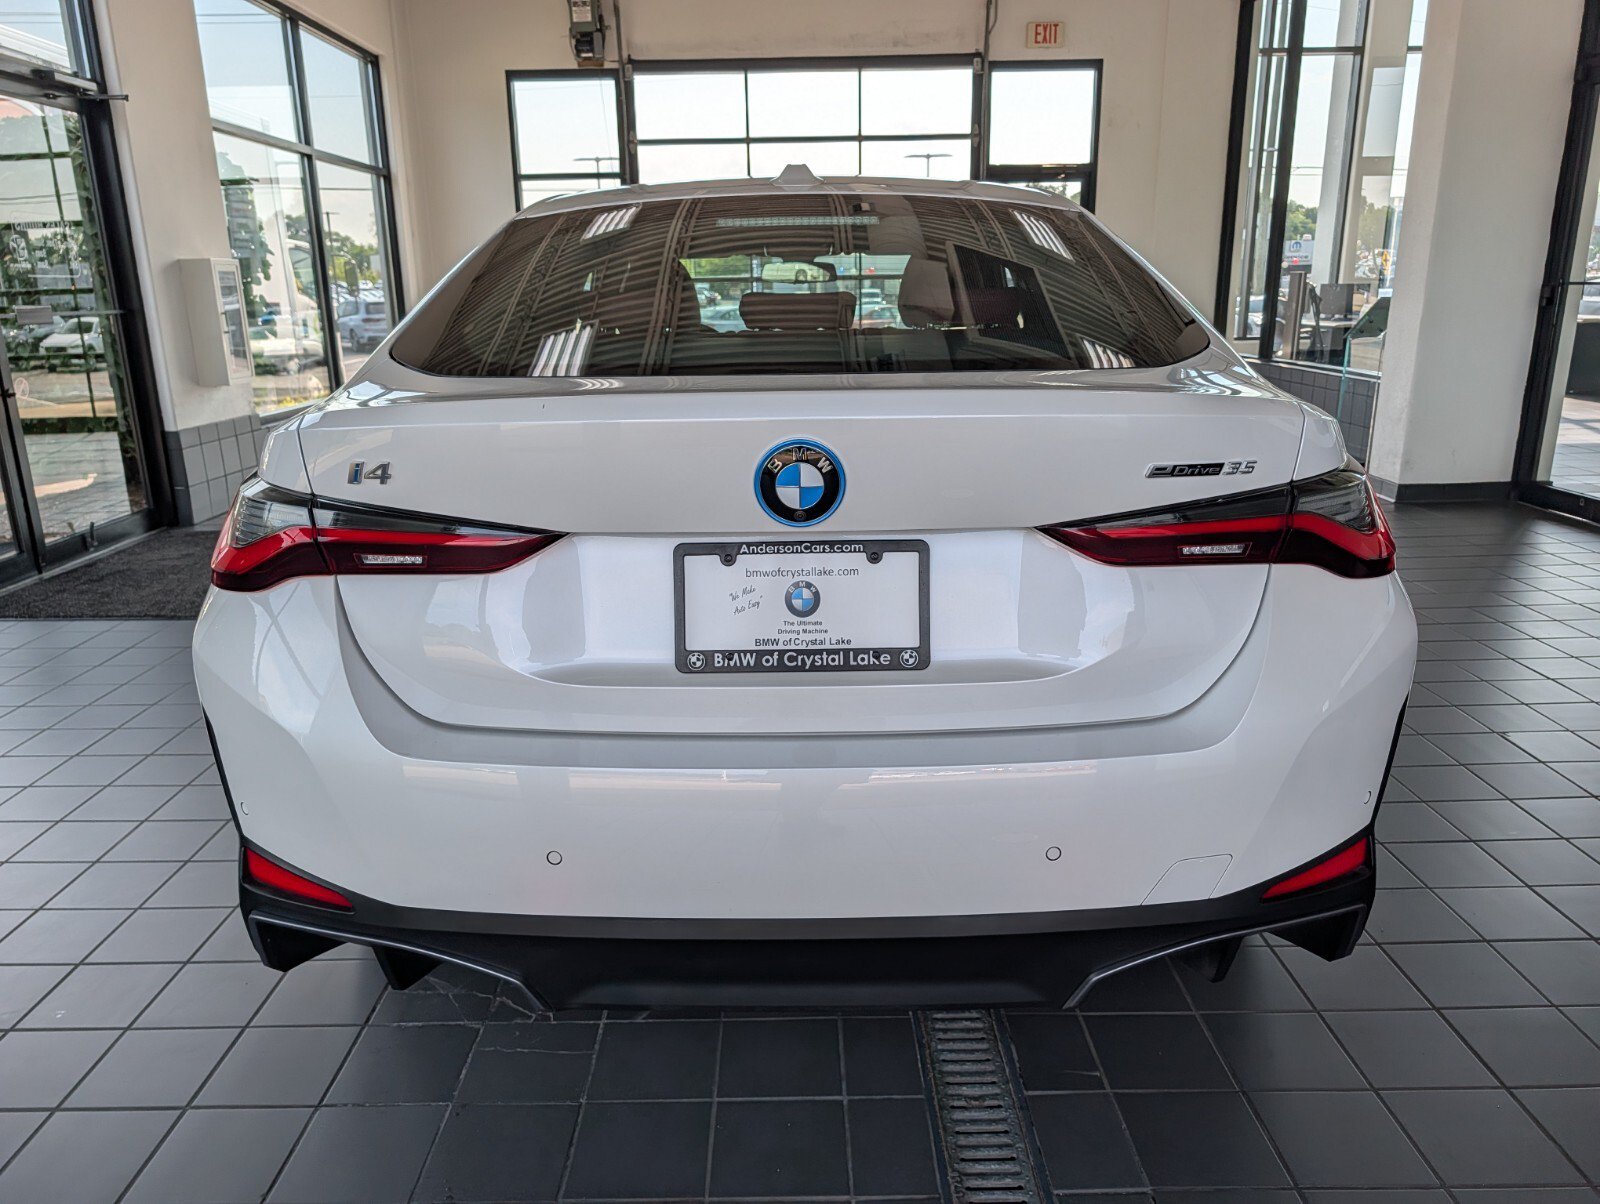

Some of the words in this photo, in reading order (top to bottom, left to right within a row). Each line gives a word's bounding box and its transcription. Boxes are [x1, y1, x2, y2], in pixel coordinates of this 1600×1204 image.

[1034, 23, 1059, 44] EXIT
[767, 447, 833, 473] BMW
[347, 461, 392, 485] i4
[740, 543, 864, 555] AndersonCars.com
[745, 567, 860, 579] bmwofcrystallake.com
[777, 628, 801, 636] Driving
[754, 638, 780, 647] BMW
[782, 638, 794, 647] of
[793, 637, 826, 649] Crystal
[829, 637, 852, 646] Lake
[714, 652, 757, 667] BMW
[761, 651, 779, 667] of
[783, 651, 844, 670] Crystal
[849, 650, 891, 666] Lake
